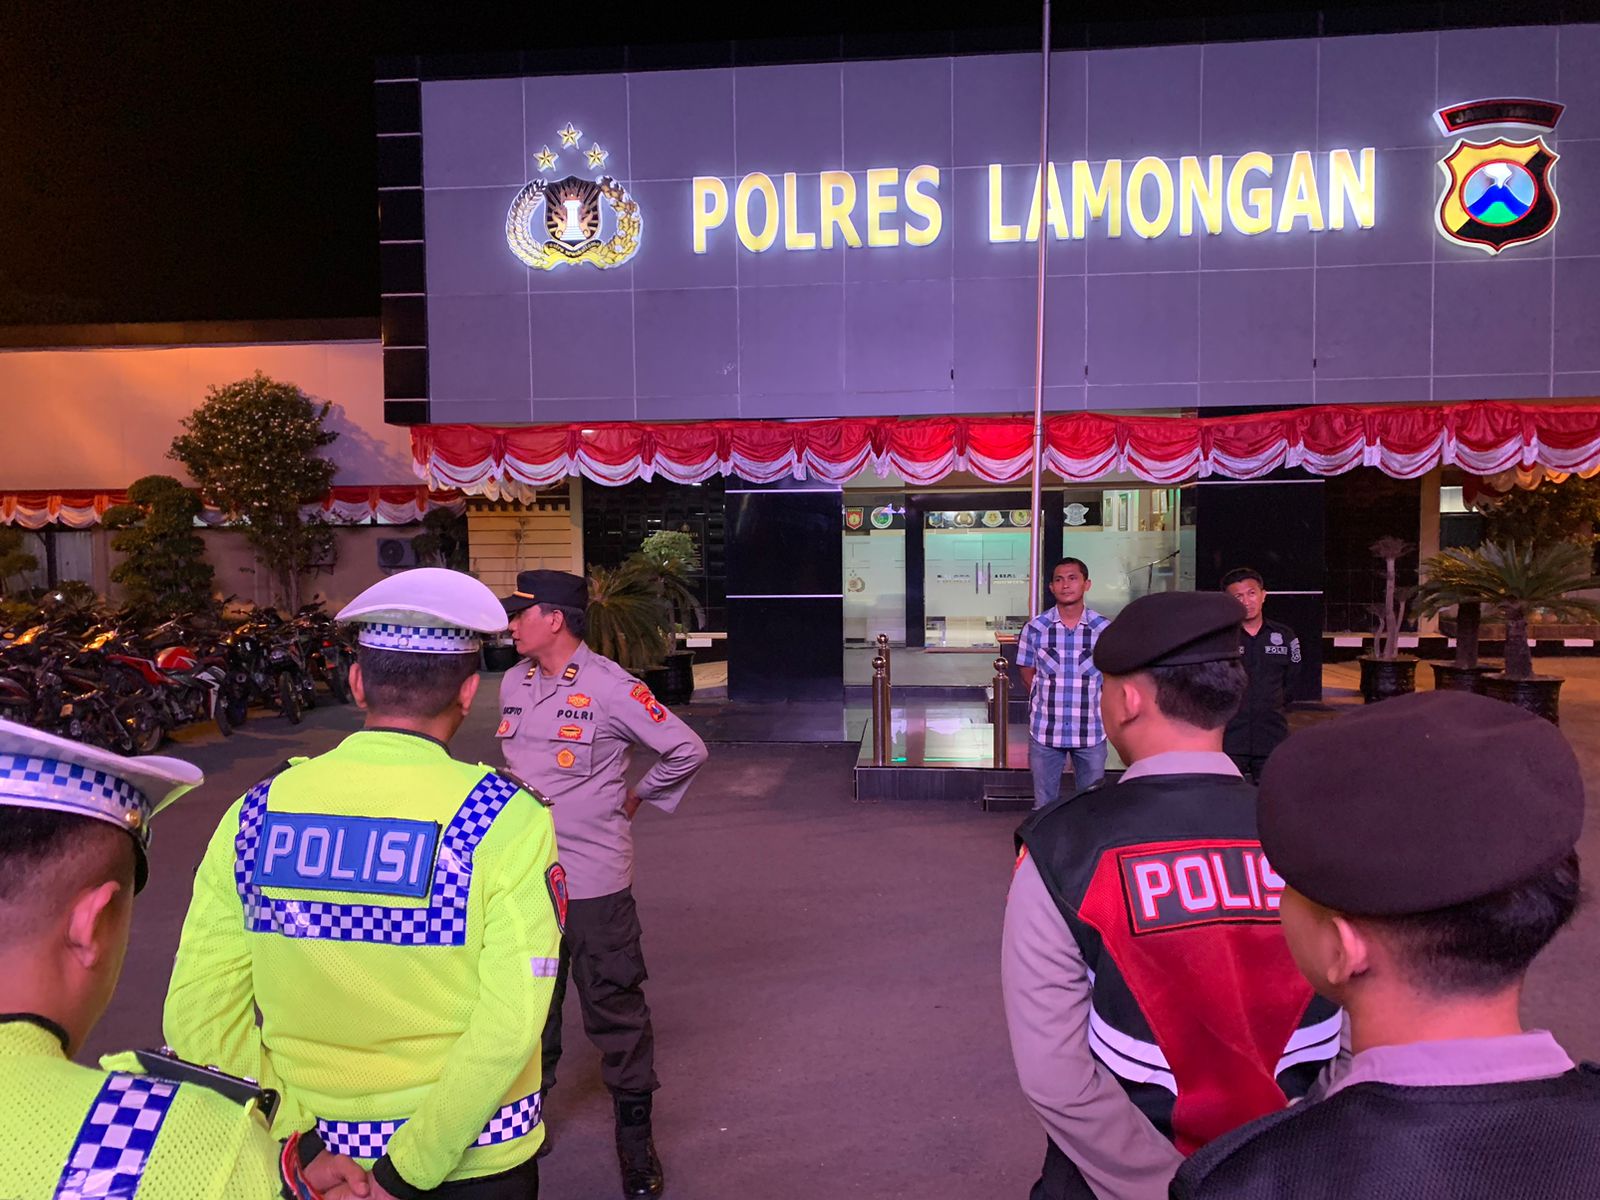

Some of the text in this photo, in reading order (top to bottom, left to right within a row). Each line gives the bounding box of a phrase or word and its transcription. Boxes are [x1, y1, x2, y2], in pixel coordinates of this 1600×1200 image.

[692, 147, 1377, 254] POLRES LAMONGAN
[556, 709, 594, 721] POLRI
[262, 824, 427, 885] POLISI
[1132, 851, 1287, 921] POLIS
